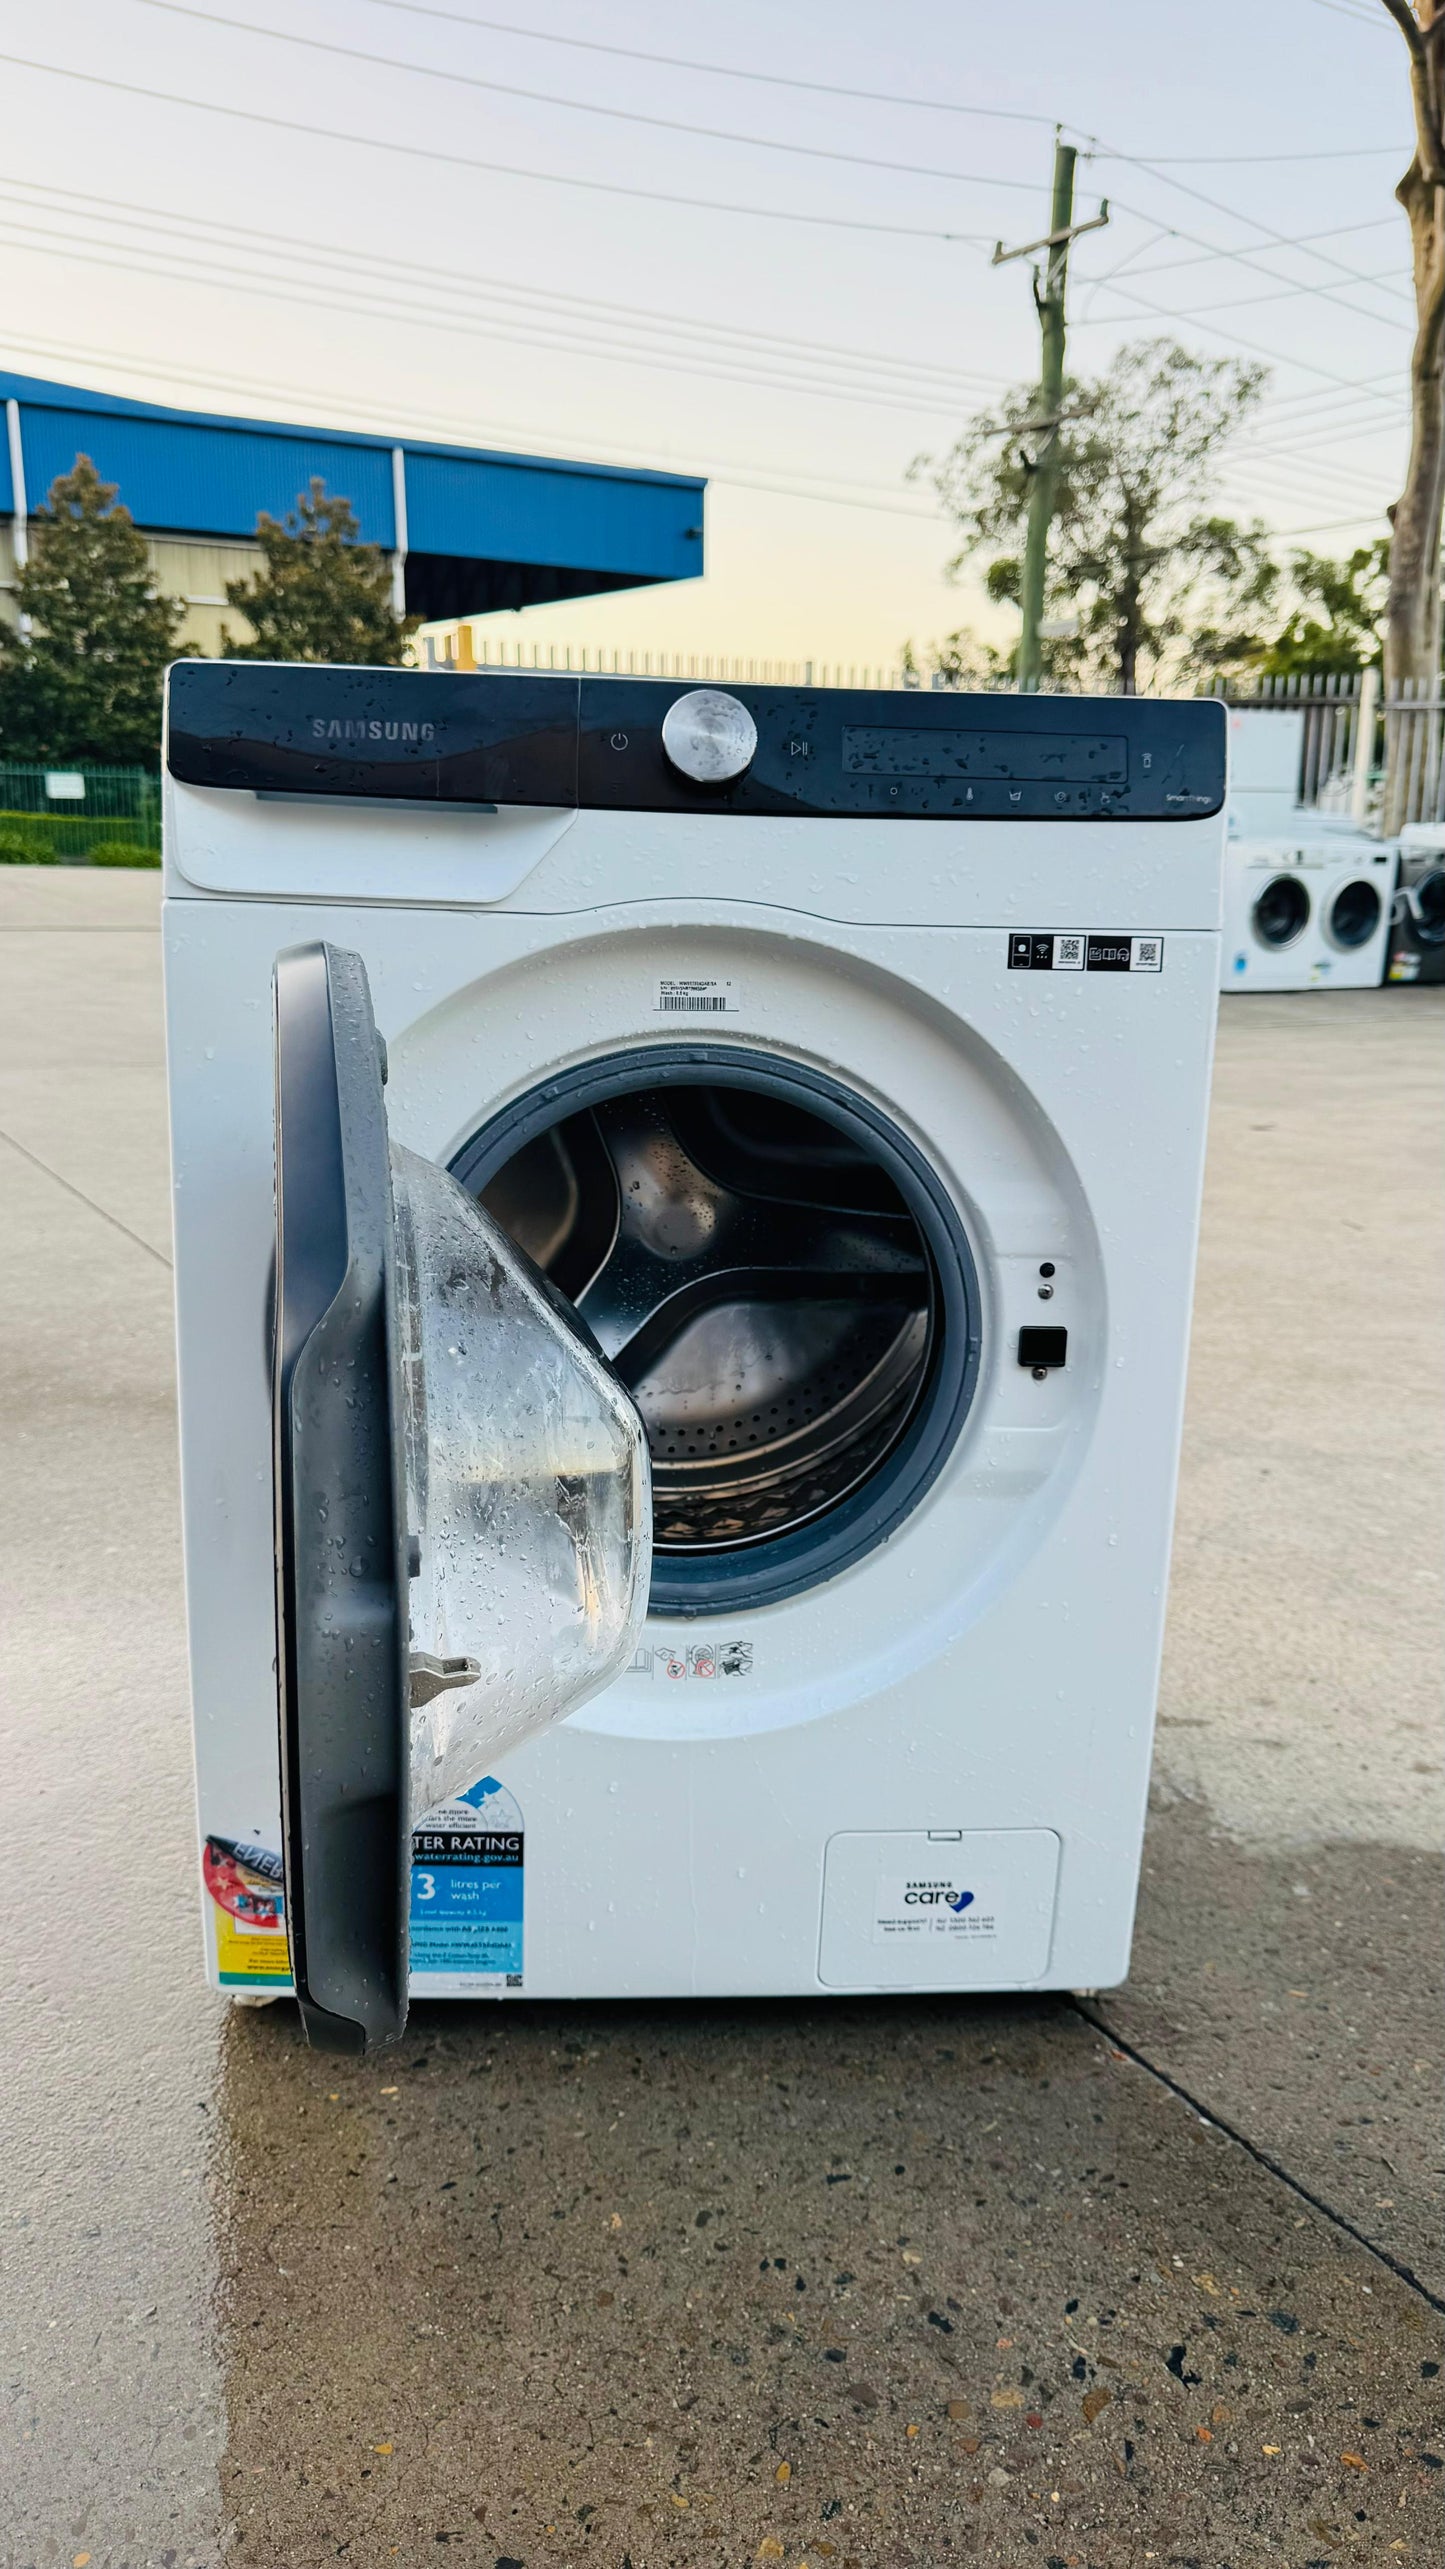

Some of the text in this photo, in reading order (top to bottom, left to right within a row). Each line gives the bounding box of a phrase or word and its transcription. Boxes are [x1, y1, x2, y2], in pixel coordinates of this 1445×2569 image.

[312, 718, 436, 742] SAMSUNG
[451, 1836, 520, 1851] RATING
[410, 1873, 502, 1900] 3 litres per
[451, 1890, 480, 1901] wash
[904, 1890, 959, 1905] care
